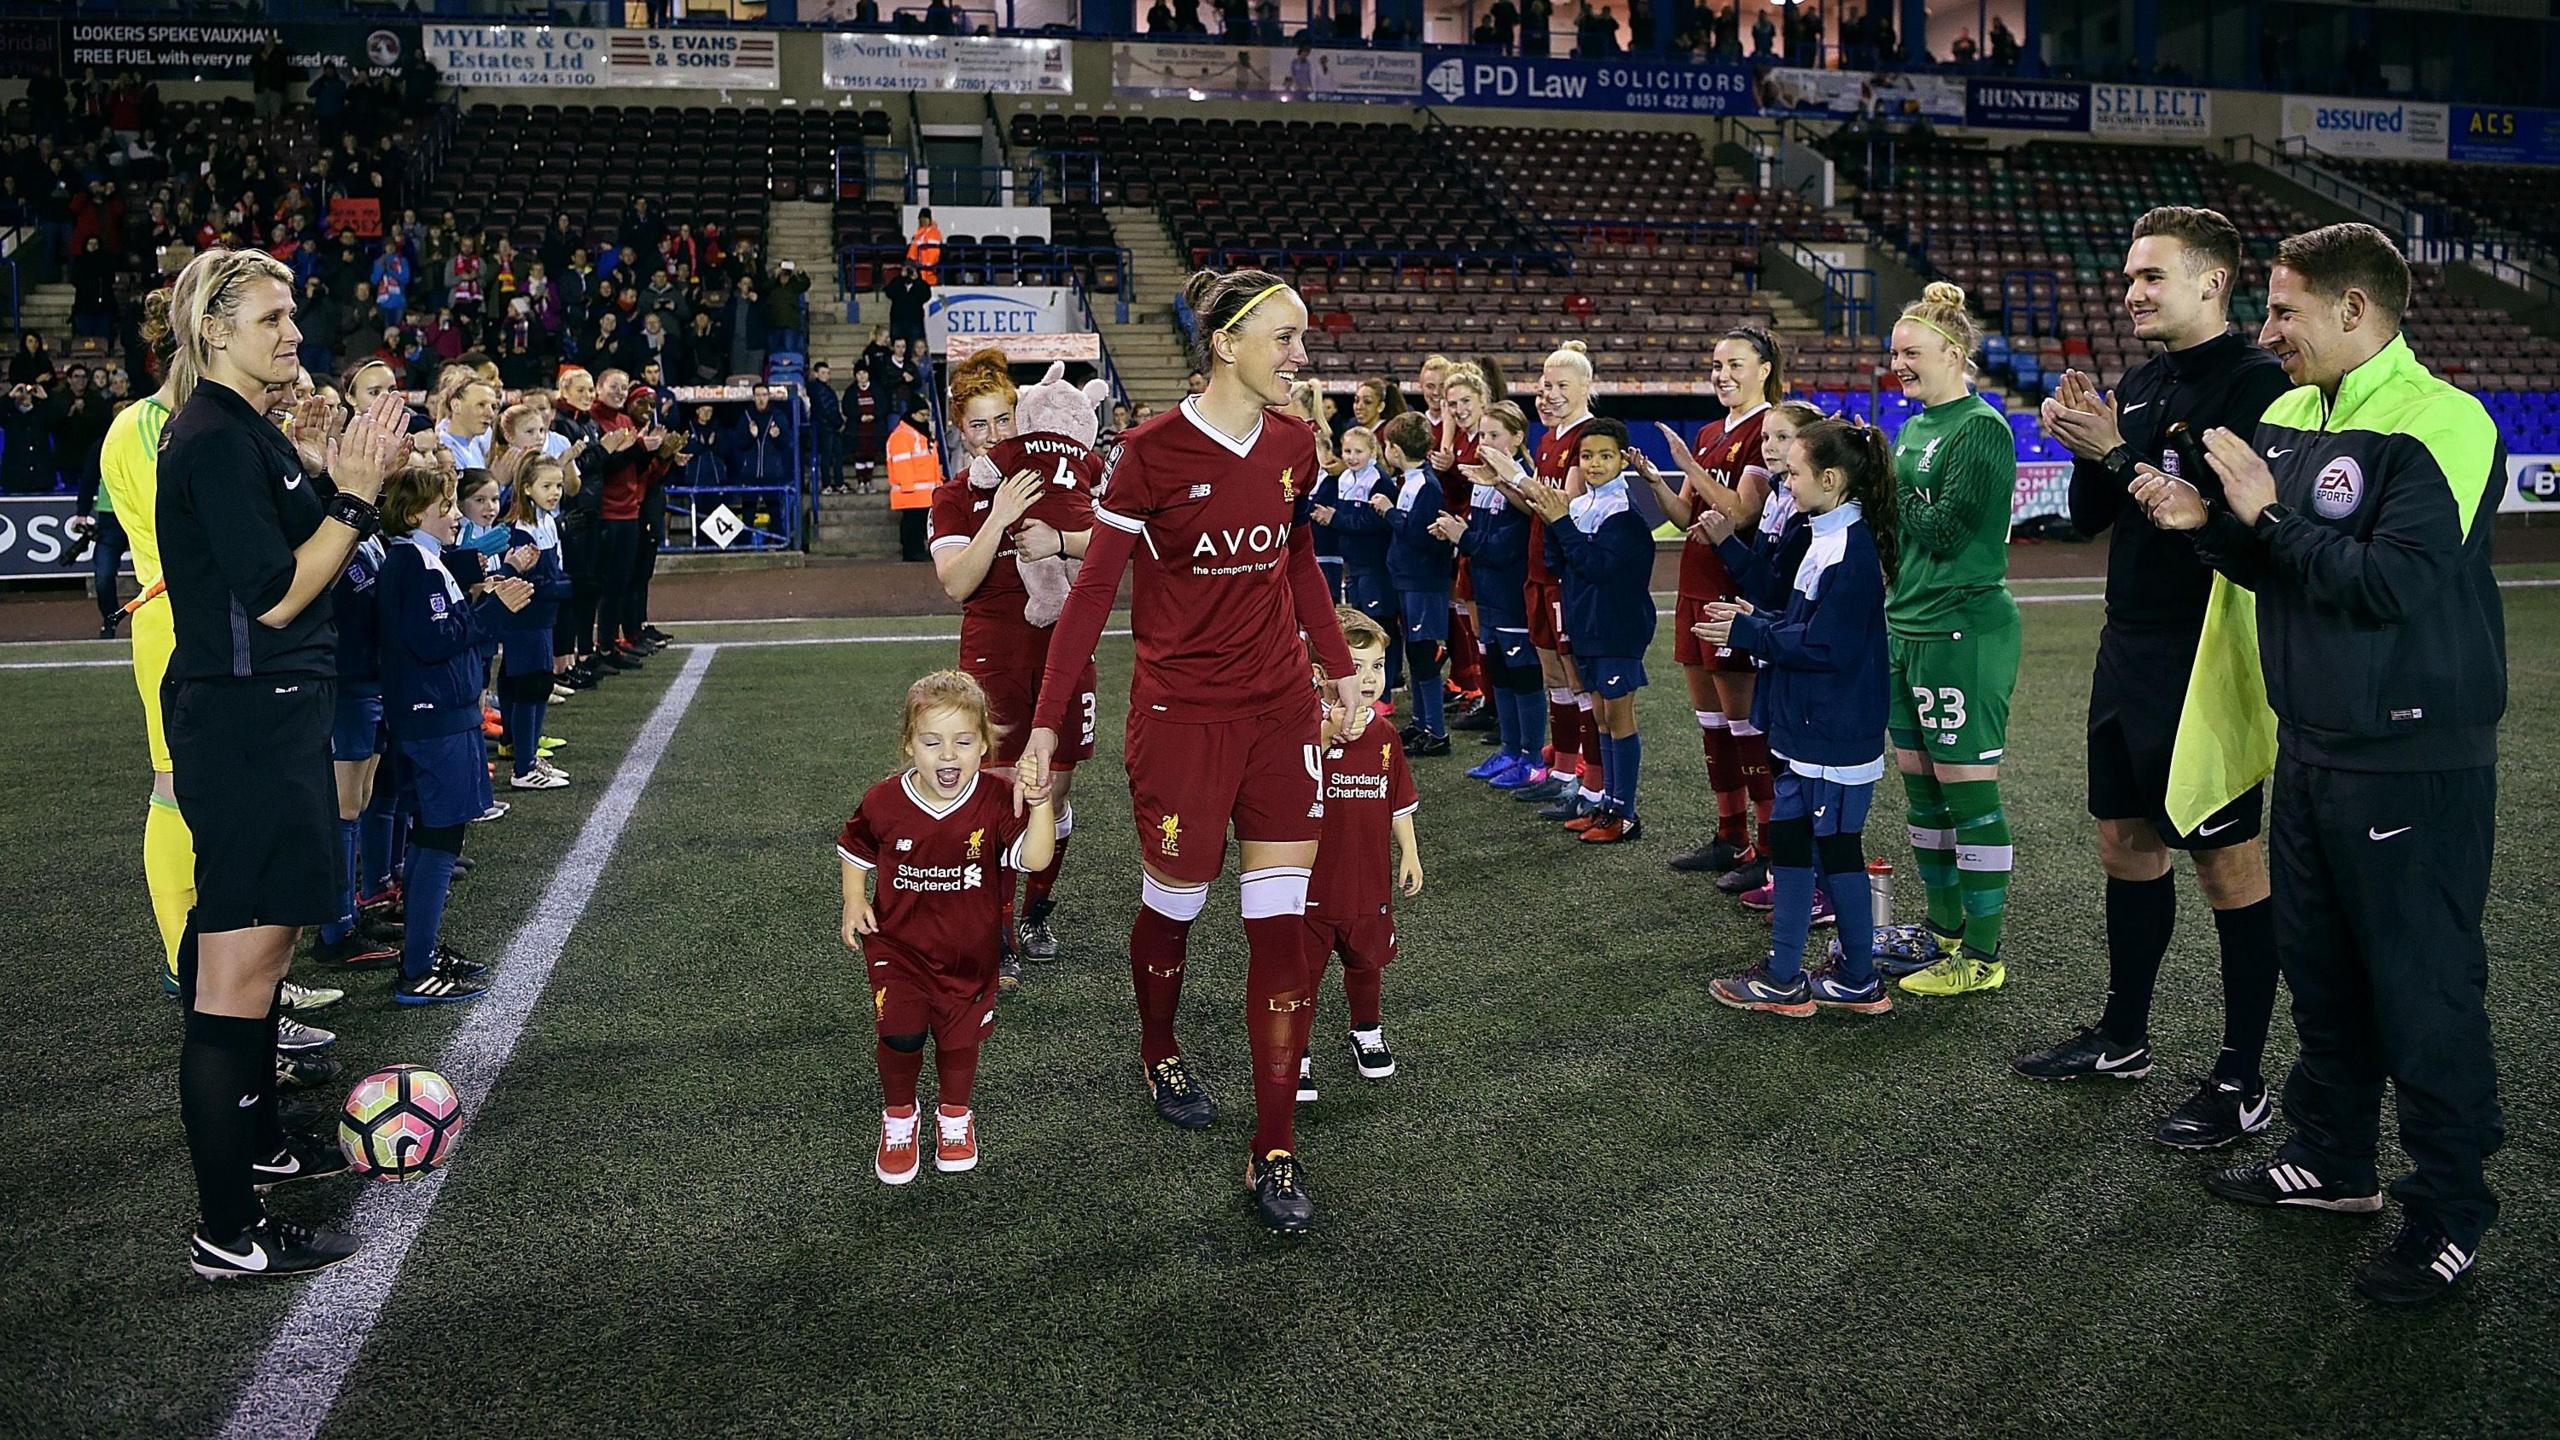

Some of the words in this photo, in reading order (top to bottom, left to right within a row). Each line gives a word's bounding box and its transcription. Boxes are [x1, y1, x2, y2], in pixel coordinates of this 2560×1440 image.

[72, 25, 146, 42] LOOKERS
[147, 26, 200, 43] SPEKE
[433, 28, 526, 49] MYLER
[536, 30, 554, 49] &
[563, 30, 594, 50] Co
[648, 35, 666, 50] S.
[672, 36, 738, 51] EVANS
[73, 47, 115, 65] FREE
[116, 48, 155, 65] FUEL
[157, 50, 190, 66] with
[191, 52, 234, 70] every
[286, 51, 321, 68] used
[448, 50, 536, 69] Estates
[544, 51, 585, 69] Ltd
[853, 43, 902, 58] North
[907, 44, 947, 59] West
[655, 53, 668, 67] &
[676, 53, 731, 68] SONS
[471, 71, 511, 83] 0151
[519, 73, 549, 84] 424
[875, 76, 897, 88] 424
[1474, 64, 1518, 97] PD
[1527, 66, 1588, 99] Law
[1596, 68, 1746, 93] SOLICITORS
[1625, 92, 1658, 108] 0151
[1663, 93, 1689, 109] 422
[1978, 87, 2081, 111] HUNTERS
[2096, 86, 2207, 117] SELECT
[2316, 105, 2403, 132] assured
[947, 310, 1038, 333] SELECT
[1024, 439, 1088, 461] MUMMY
[1052, 456, 1078, 490] 4
[2318, 468, 2354, 493] EA
[2316, 490, 2355, 504] SPORTS
[715, 517, 734, 535] 4
[1192, 522, 1292, 560] AVON
[1192, 565, 1210, 579] the
[1211, 563, 1254, 580] company
[1254, 561, 1268, 574] for
[1912, 686, 1967, 730] 23
[1330, 772, 1381, 786] Standard
[1325, 786, 1380, 799] Chartered
[897, 864, 961, 880] Standard
[892, 878, 961, 894] Chartered
